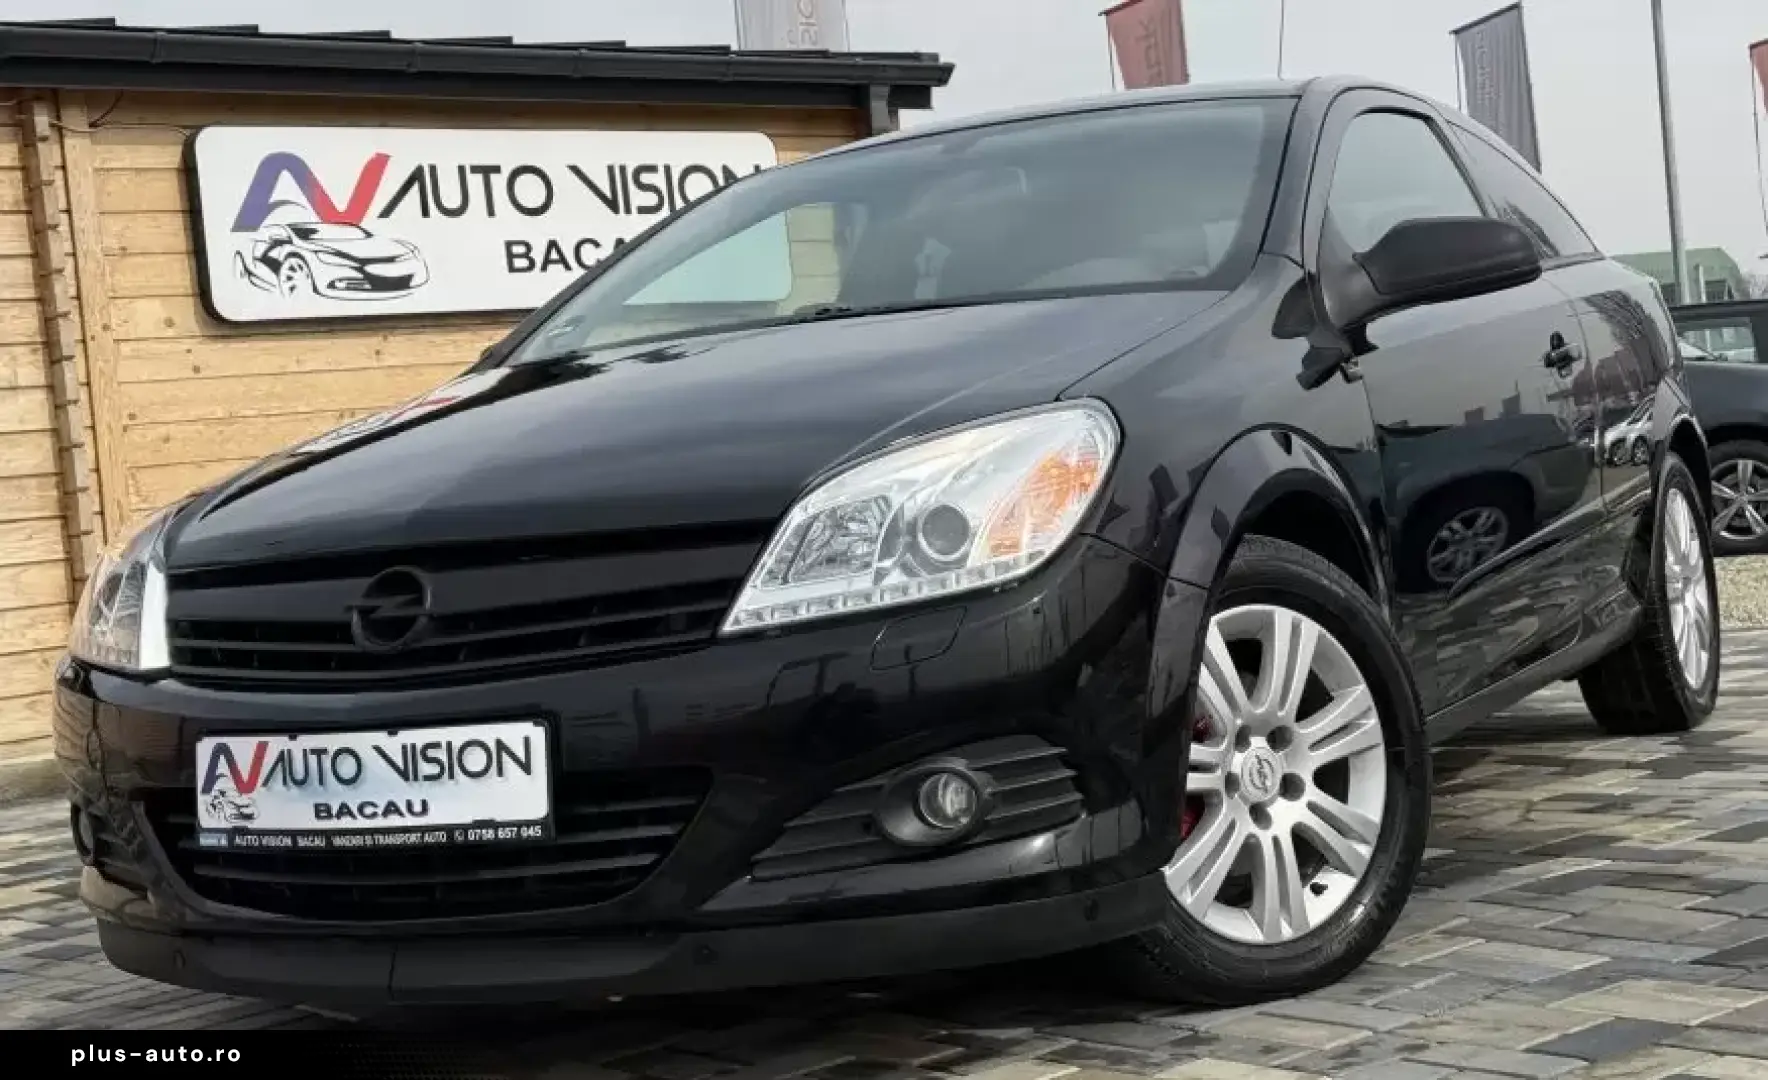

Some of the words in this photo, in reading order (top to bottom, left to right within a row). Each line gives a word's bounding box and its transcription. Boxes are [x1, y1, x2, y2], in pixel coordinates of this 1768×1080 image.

[377, 163, 554, 218] AUTO
[567, 163, 761, 215] VISIO
[504, 237, 625, 273] BAC
[261, 747, 363, 787] AUTO
[371, 735, 532, 783] VISION
[314, 799, 429, 821] BACAU
[234, 835, 259, 847] AUTO
[260, 835, 293, 847] VISION
[374, 832, 422, 846] TRANSPORT
[424, 831, 447, 843] AUTO
[498, 827, 518, 839] 657
